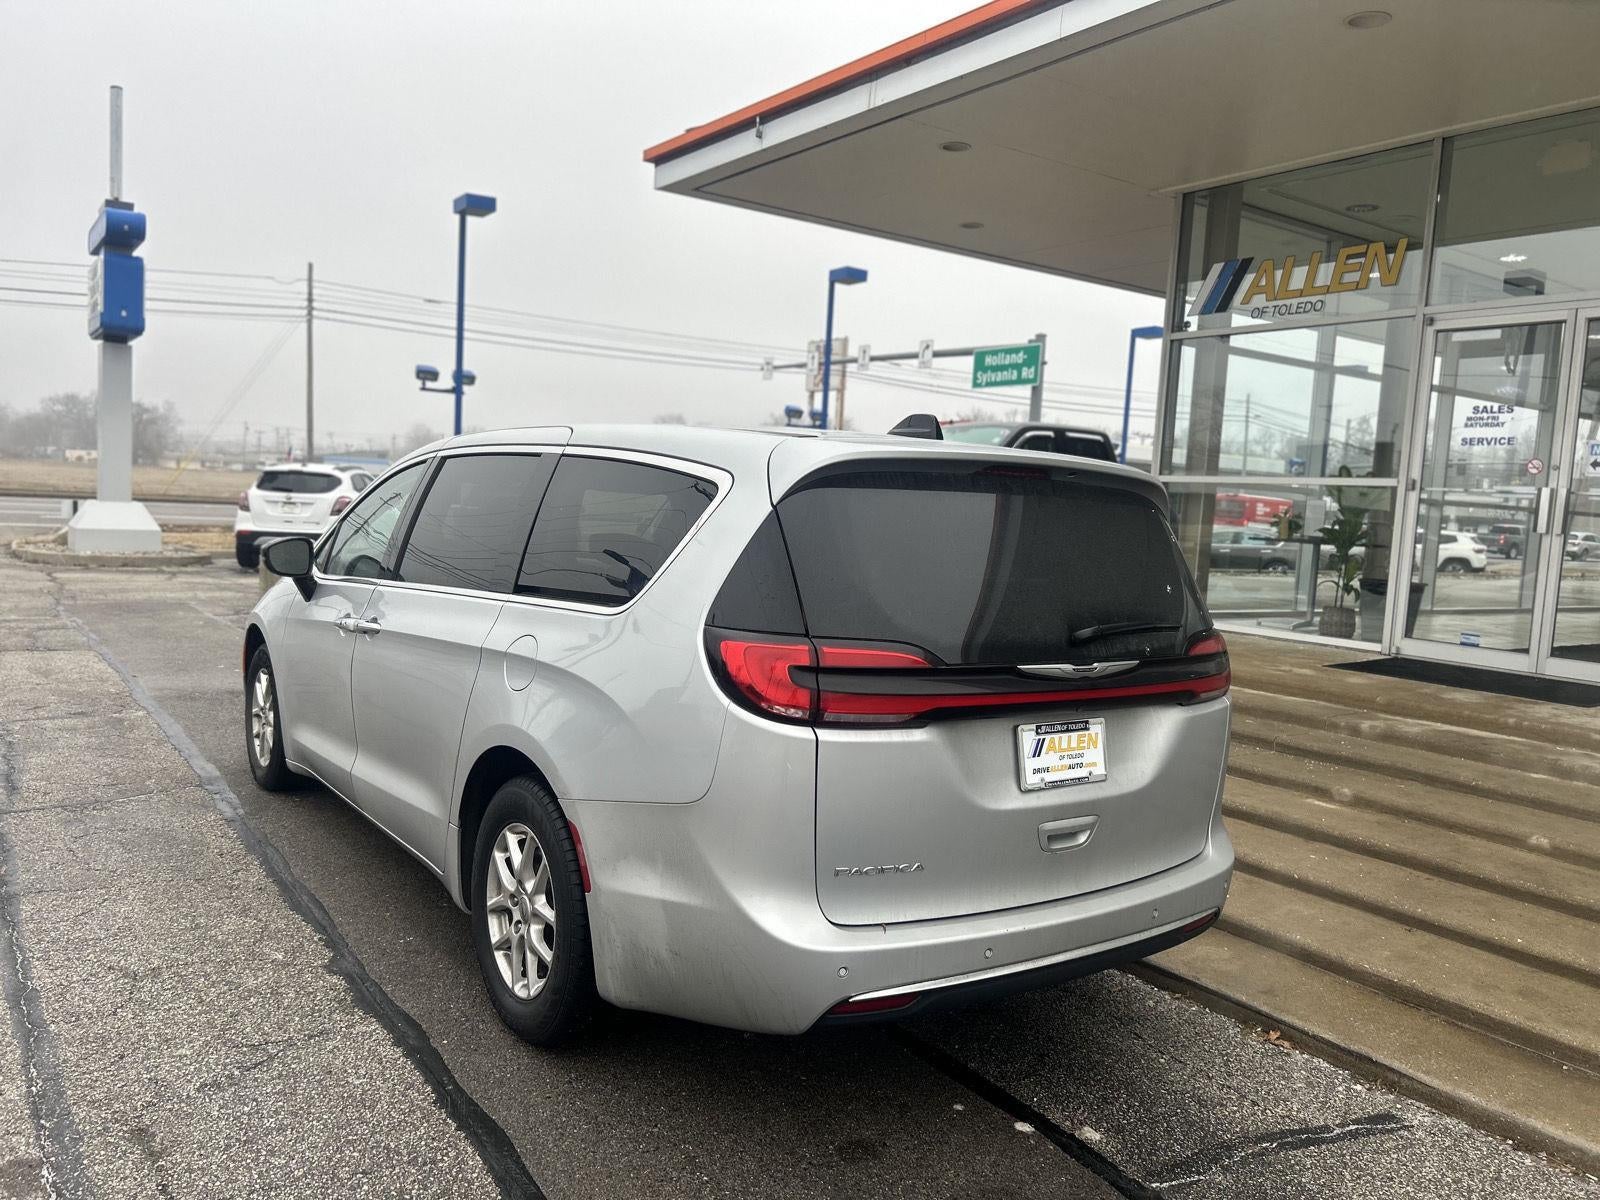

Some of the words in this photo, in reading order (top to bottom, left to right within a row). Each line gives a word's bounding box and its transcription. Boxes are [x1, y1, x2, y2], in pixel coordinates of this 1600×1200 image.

[1240, 237, 1408, 305] ALLEN
[1250, 306, 1269, 319] OF
[1271, 299, 1324, 317] TOLEDO
[984, 350, 1028, 366] Holland-
[976, 368, 1018, 386] Sylvania
[1021, 366, 1035, 379] Rd
[1472, 404, 1514, 415] SALES
[1460, 436, 1516, 447] SERVICE
[1045, 732, 1099, 755] ALLEN
[1067, 752, 1085, 760] TOLEDO
[833, 862, 925, 877] PACIFICA
